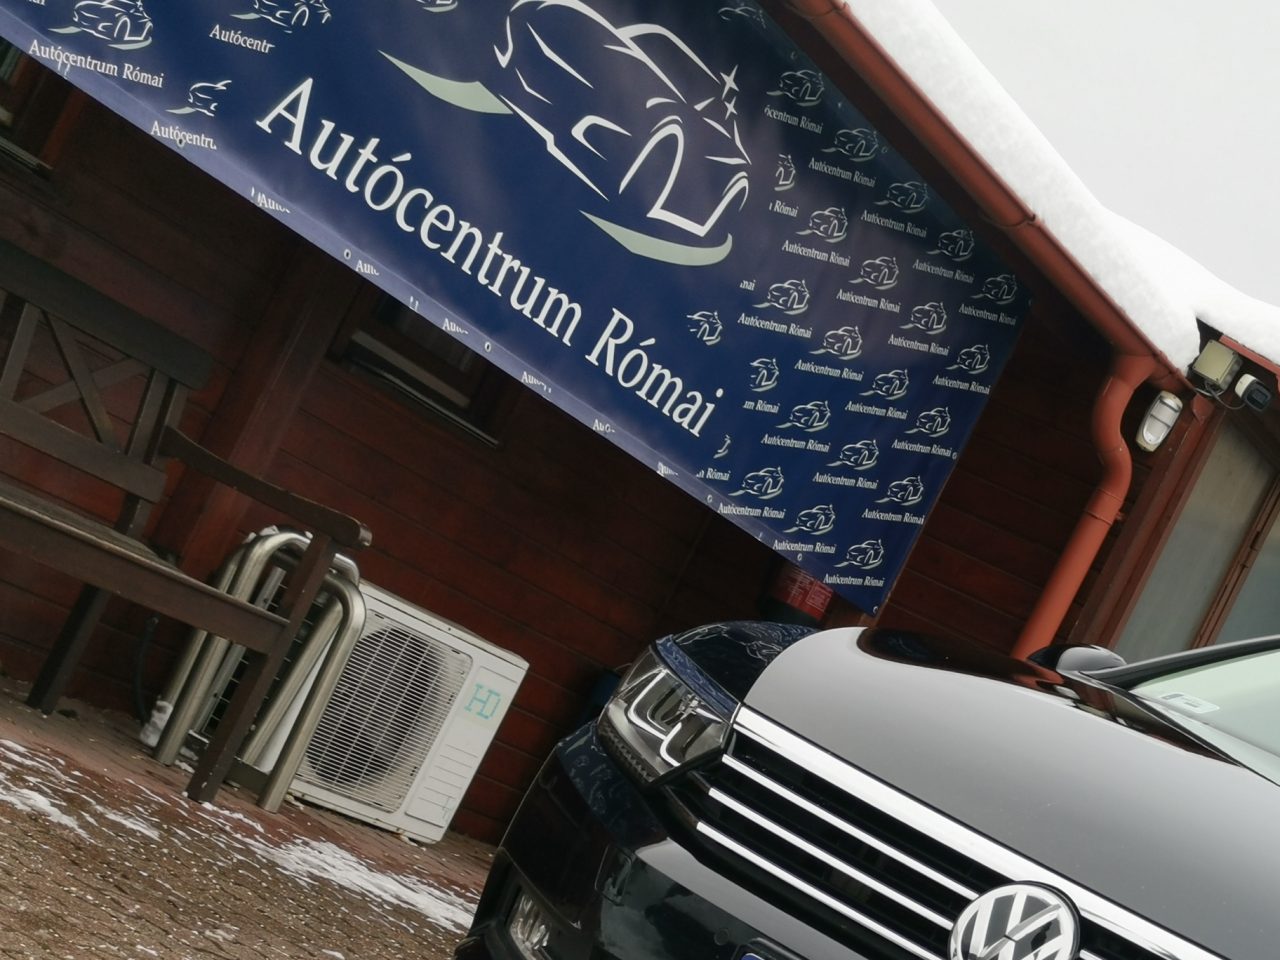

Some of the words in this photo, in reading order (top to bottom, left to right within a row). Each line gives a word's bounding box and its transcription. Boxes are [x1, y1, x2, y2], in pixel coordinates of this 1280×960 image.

[29, 39, 118, 77] Autócentrum
[122, 63, 164, 88] Római
[800, 116, 824, 134] Római
[774, 200, 799, 217] Római
[256, 77, 584, 347] Autócentrum
[583, 307, 724, 437] Római
